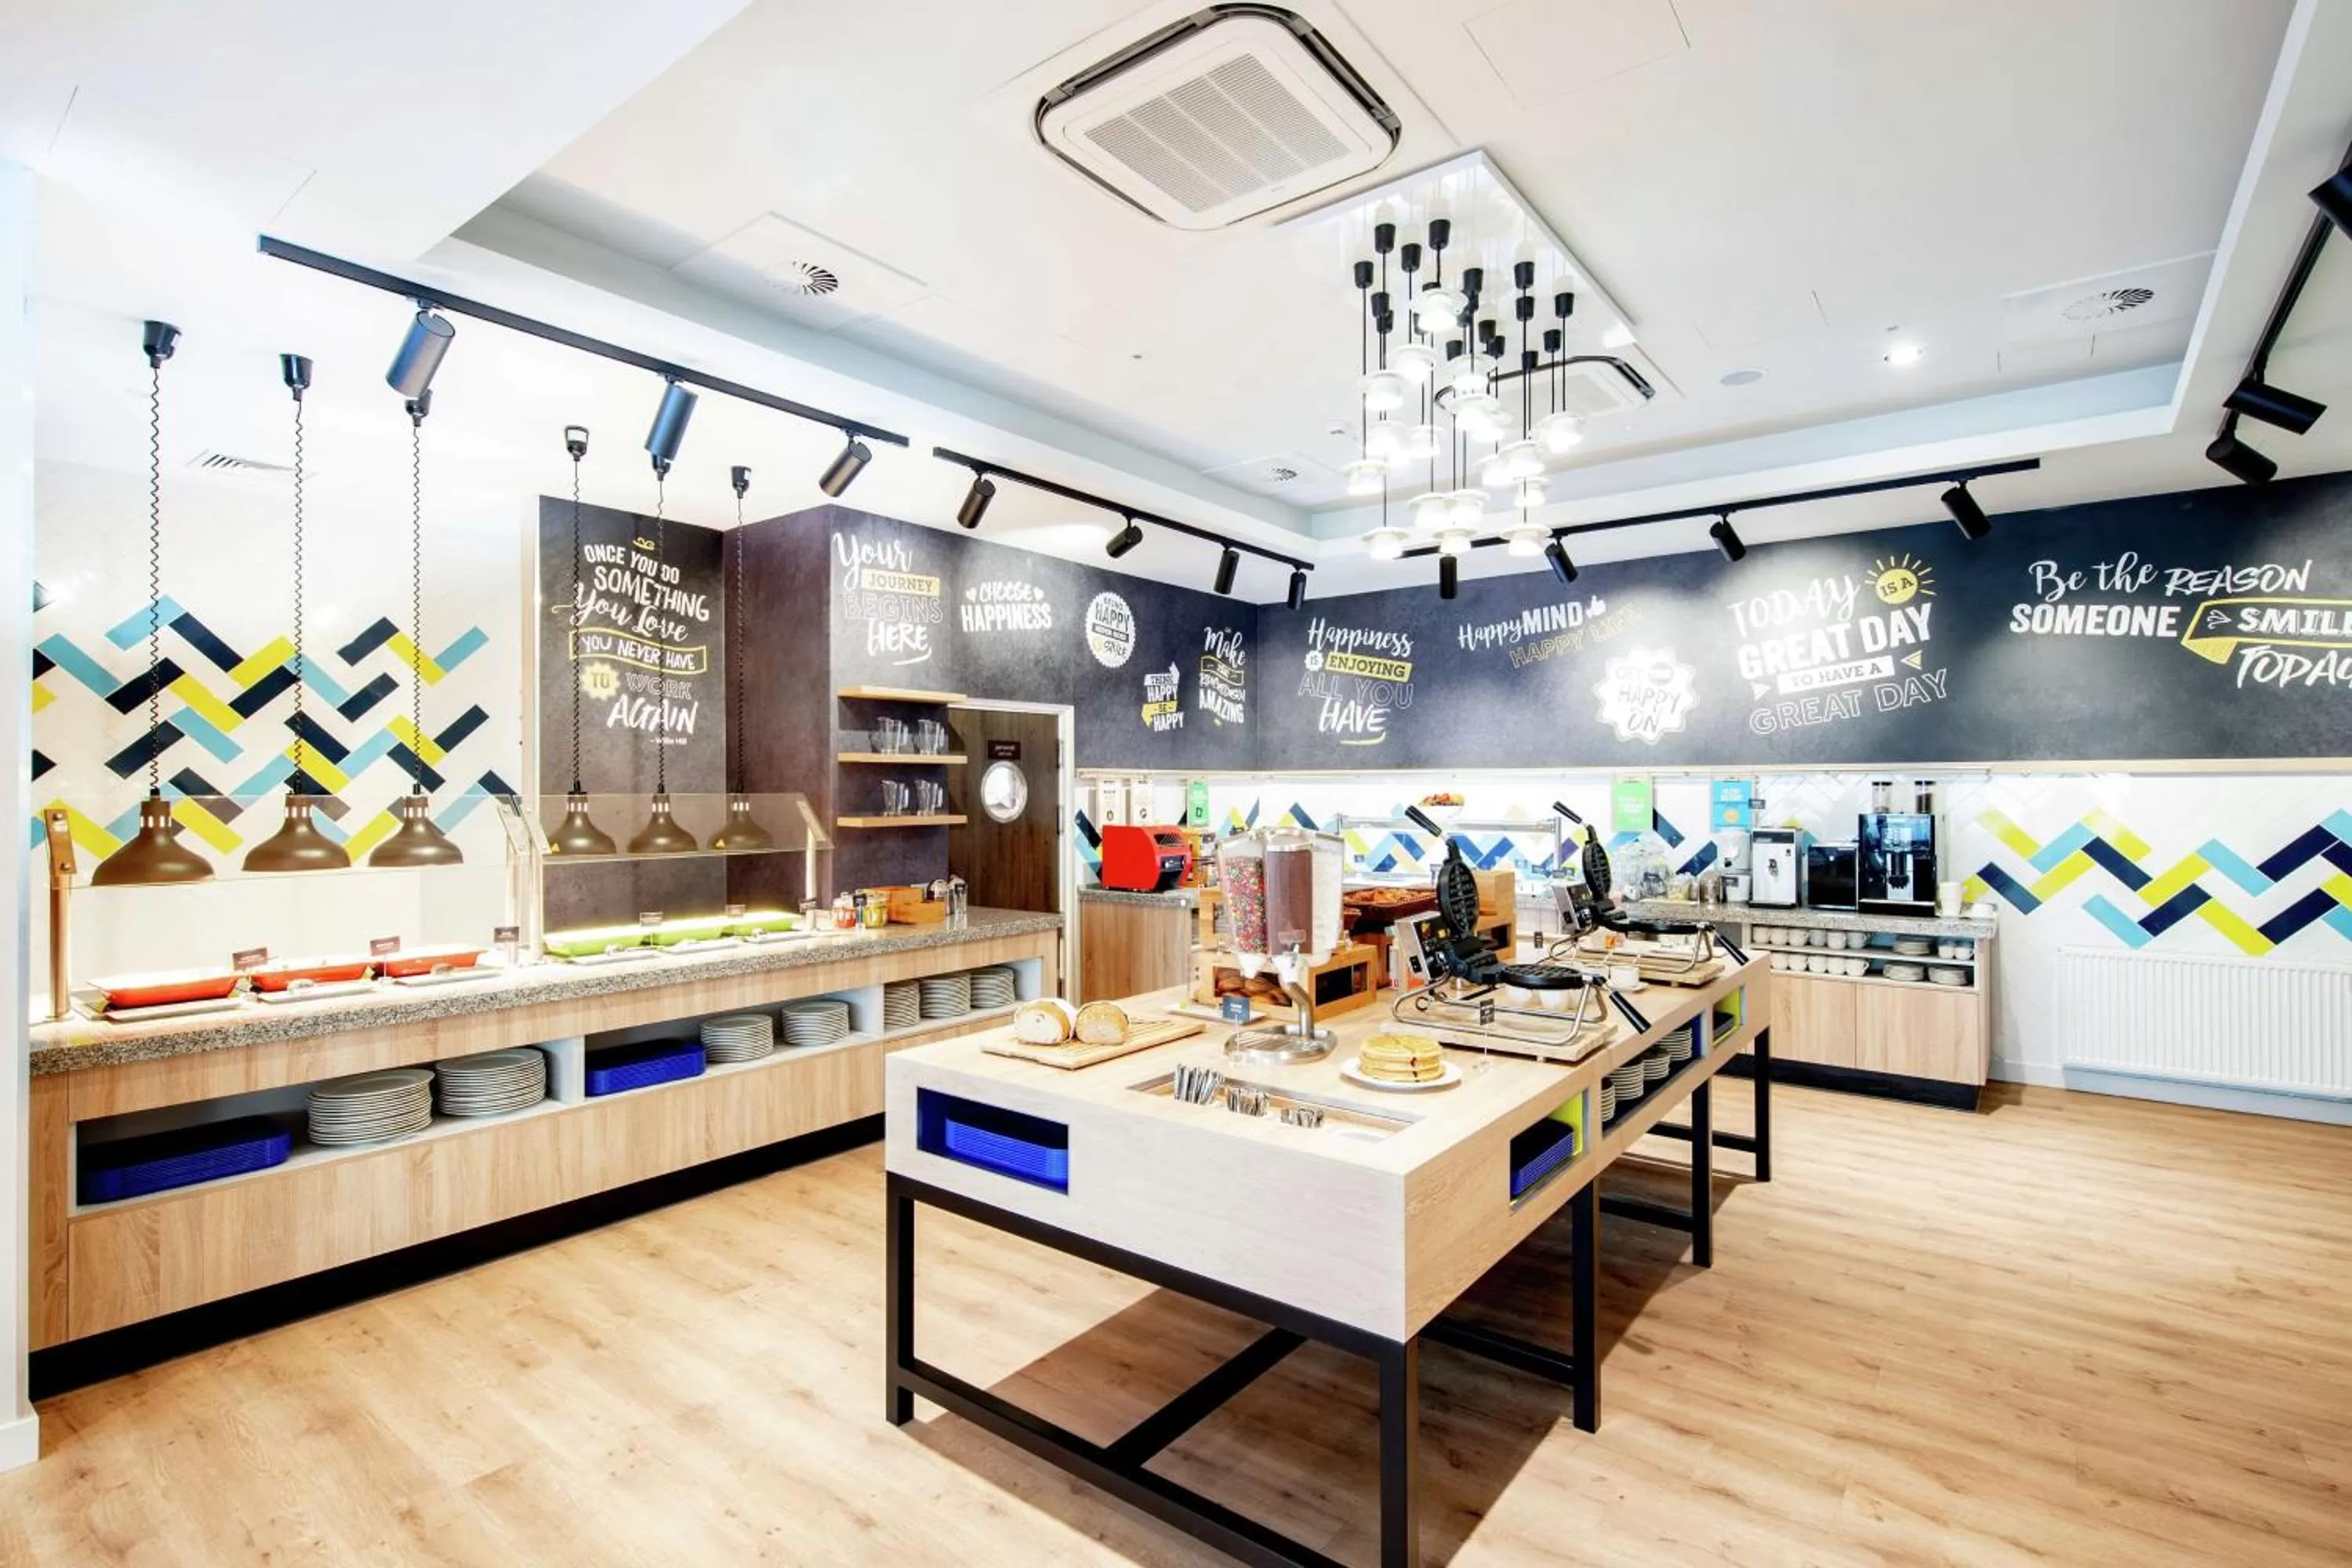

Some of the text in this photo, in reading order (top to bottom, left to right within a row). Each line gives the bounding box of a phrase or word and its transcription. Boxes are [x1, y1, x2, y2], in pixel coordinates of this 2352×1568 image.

[584, 545, 680, 584] ONCE YOU DO
[2028, 550, 2313, 603] Be the REASON
[593, 565, 710, 622] SOMETHING
[869, 573, 932, 593] JOURNEY
[1882, 576, 1915, 597] IS A
[570, 583, 688, 642] You Love
[842, 591, 943, 623] BEGINS
[960, 602, 1053, 633] HAPPINESS
[1095, 601, 1129, 632] HAPPY
[2009, 603, 2182, 637] SOMEONE
[582, 636, 695, 670] YOU NEVER HAVE
[866, 617, 929, 657] HERE
[1204, 626, 1246, 669] Make
[1308, 616, 1414, 658] Happiness
[1508, 630, 1584, 670] HAPPY
[1738, 602, 1933, 681] GREAT DAY
[591, 672, 610, 689] TO
[1330, 656, 1406, 678] ENJOYING
[1818, 666, 1865, 684] HAVE
[1869, 663, 1883, 676] A
[1147, 684, 1178, 703] HAPPY
[1199, 688, 1244, 724] AMAZING
[1298, 671, 1414, 710] ALL YOU
[1617, 683, 1682, 716] HAPPY
[1749, 668, 1947, 735] GREAT DAY
[607, 693, 698, 733] AGAIN
[1153, 711, 1185, 731] HAPPY
[1319, 698, 1391, 733] HAVE
[1628, 708, 1664, 733] ON
